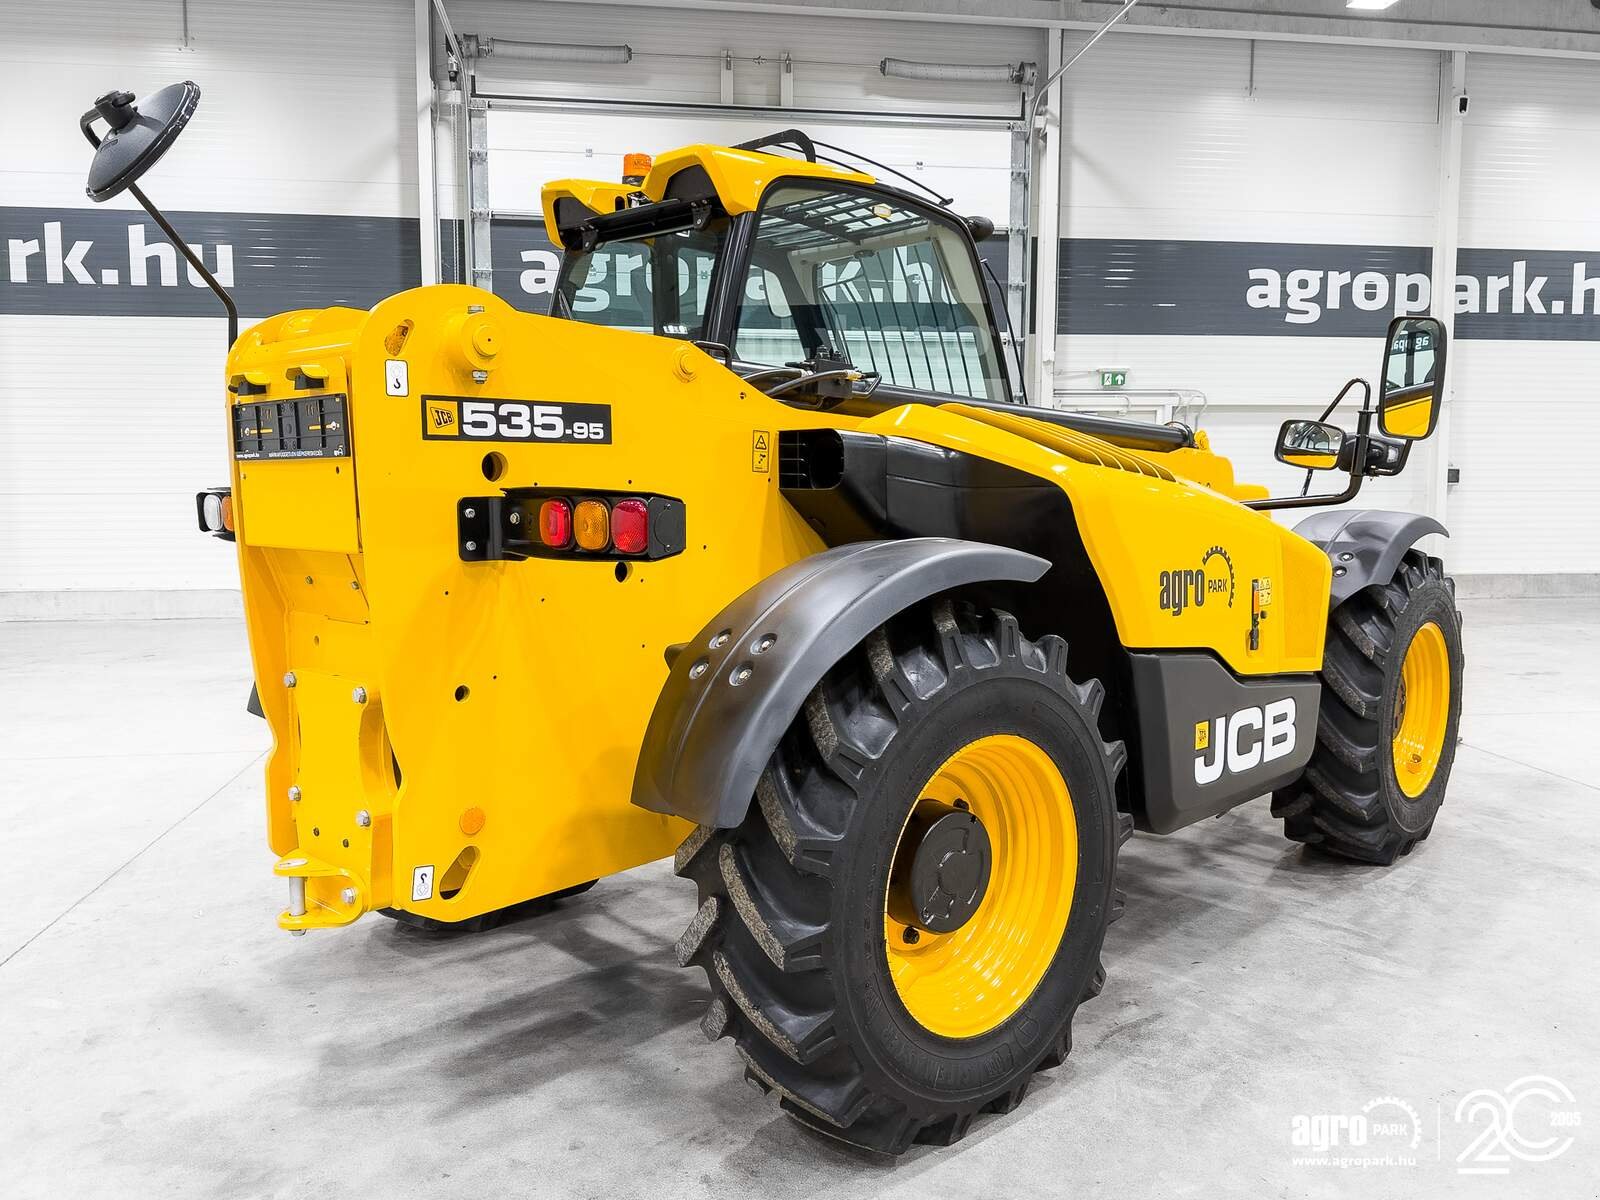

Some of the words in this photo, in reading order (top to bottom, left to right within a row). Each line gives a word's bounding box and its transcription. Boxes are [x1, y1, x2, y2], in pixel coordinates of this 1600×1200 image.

[8, 221, 235, 288] rk.hu
[519, 246, 957, 316] agrak.h
[434, 408, 454, 426] JCB
[462, 401, 605, 440] 535-95
[1159, 569, 1205, 617] agro
[1207, 579, 1228, 594] PARK
[1194, 697, 1297, 785] JCB
